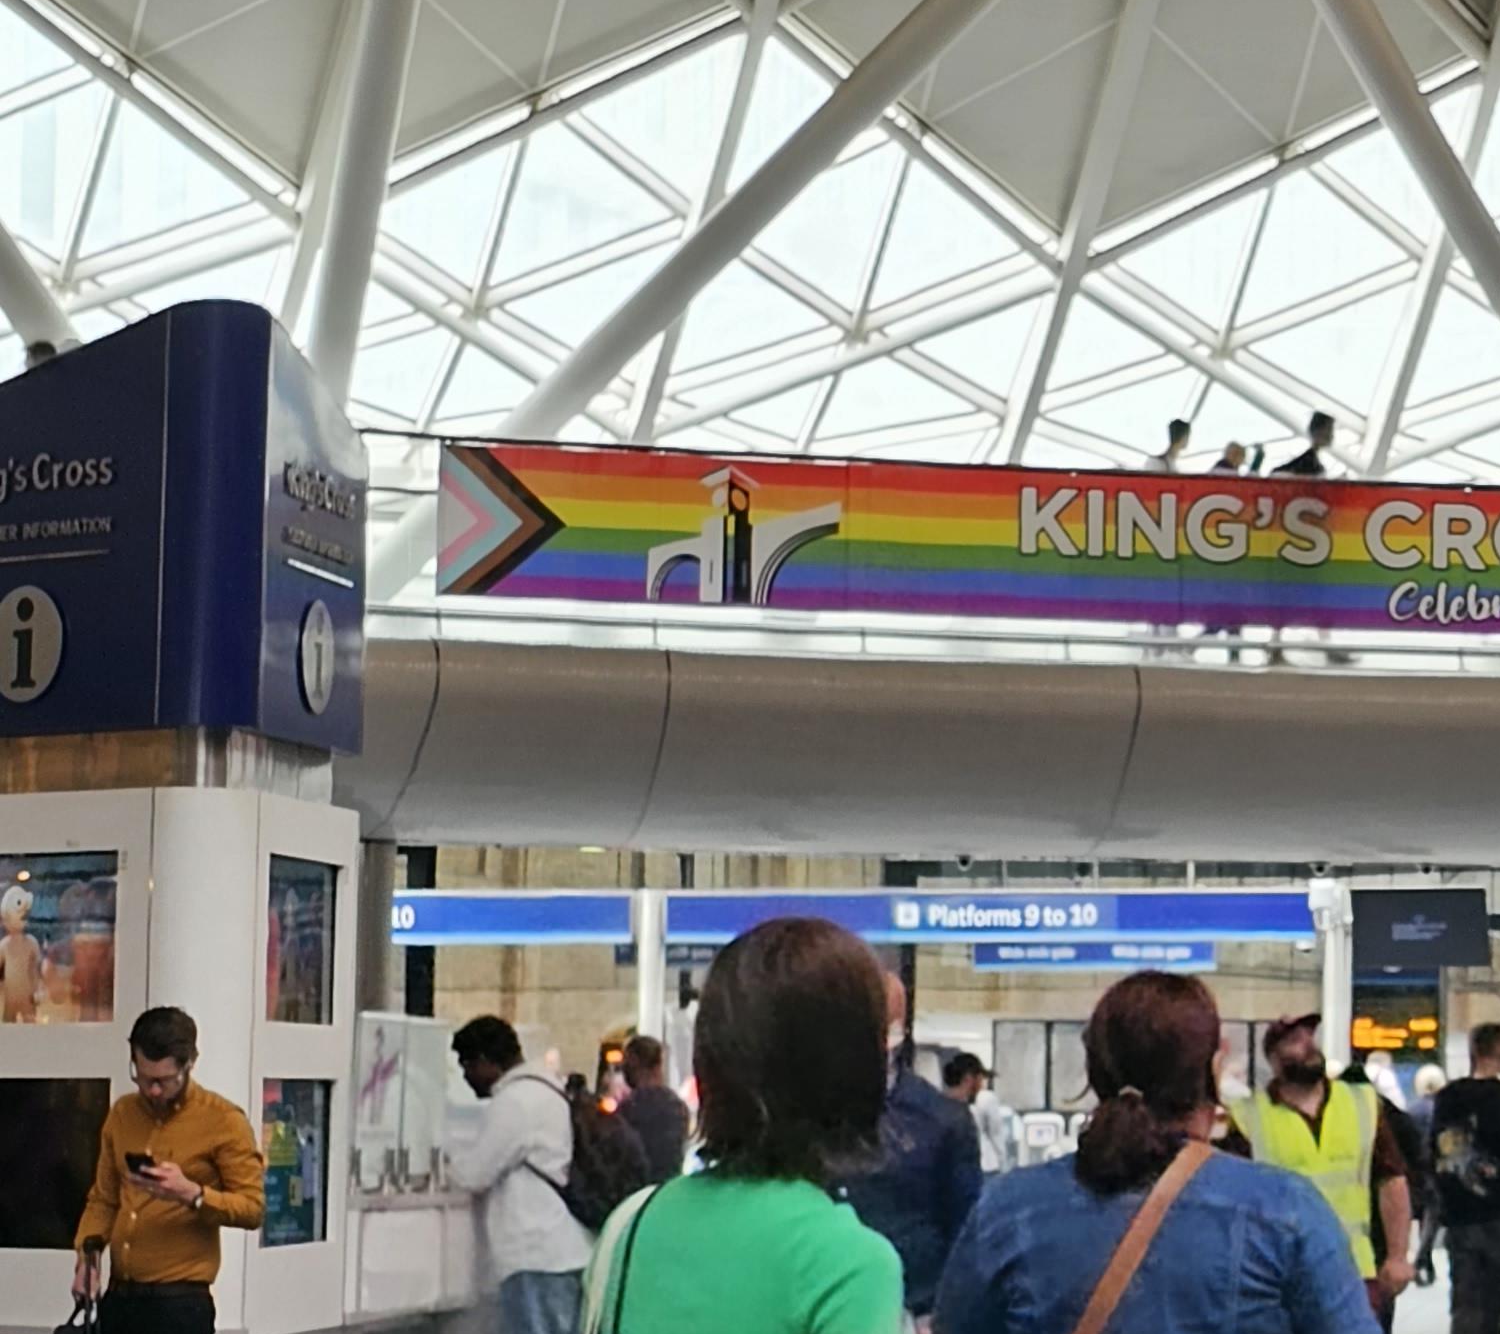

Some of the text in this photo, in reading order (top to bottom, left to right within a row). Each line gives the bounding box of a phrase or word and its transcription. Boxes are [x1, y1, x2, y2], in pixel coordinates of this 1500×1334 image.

[31, 452, 113, 491] Cross
[22, 516, 112, 541] INFORMATION
[1018, 485, 1334, 566] KING'S
[928, 903, 1098, 929] Platforms 9 to 10
